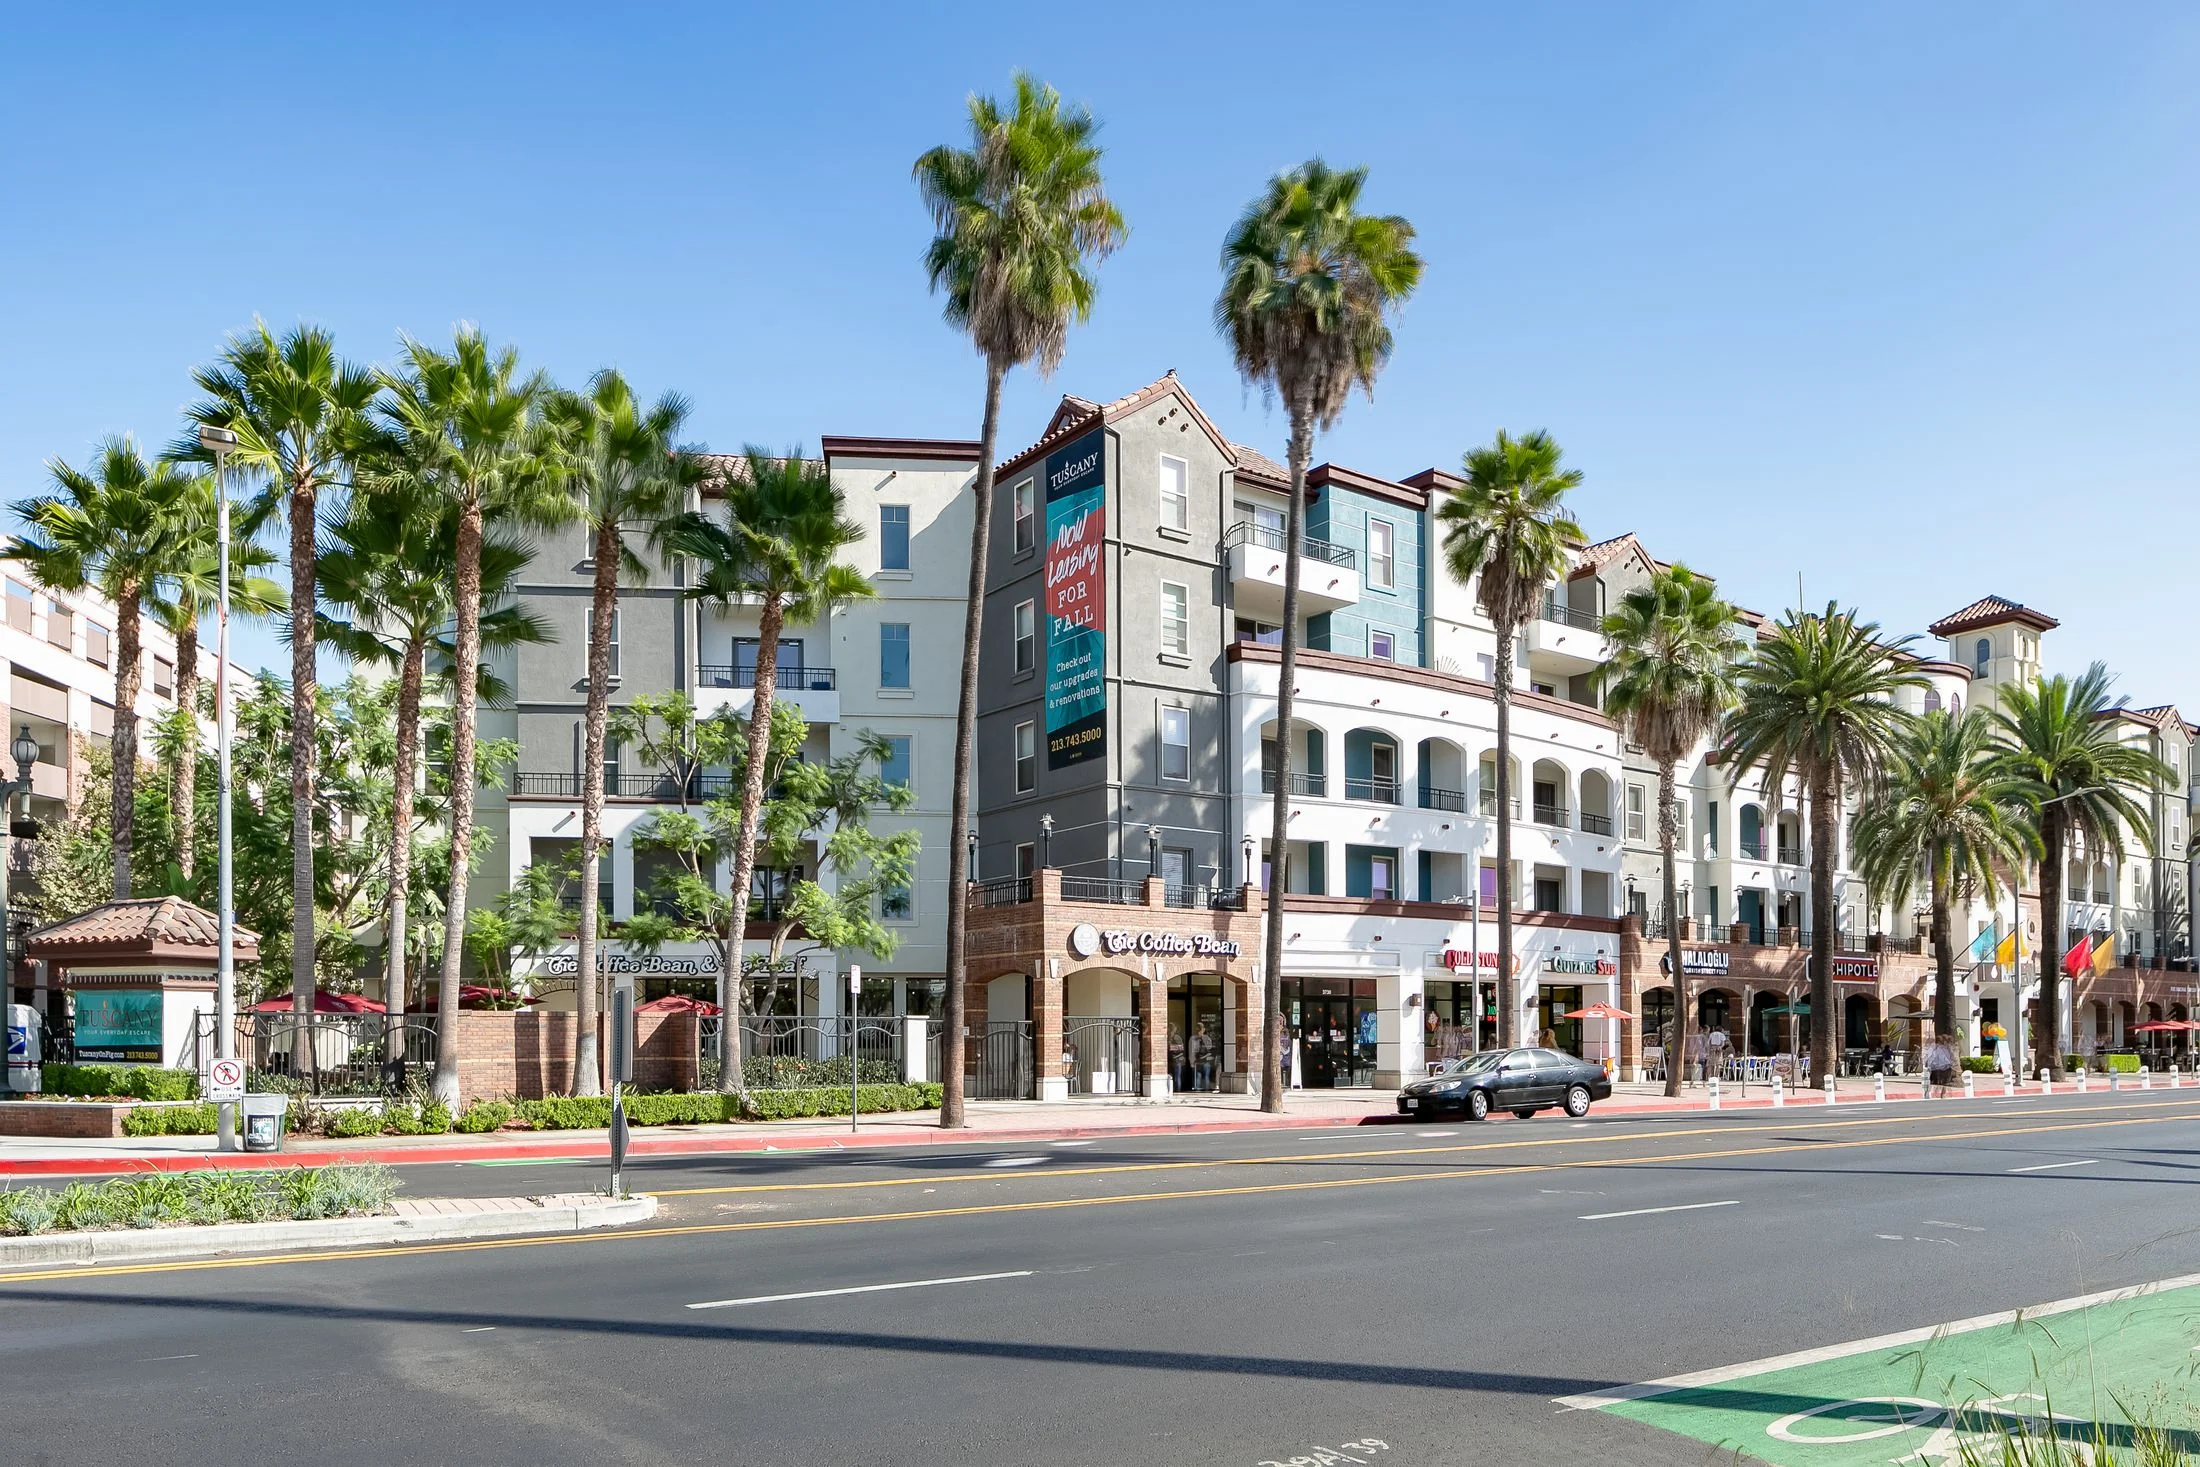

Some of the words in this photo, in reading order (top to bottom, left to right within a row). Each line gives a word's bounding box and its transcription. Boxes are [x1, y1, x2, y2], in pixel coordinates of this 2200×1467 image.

[1050, 451, 1098, 487] TUSCANY
[1047, 543, 1099, 588] Leasing
[1058, 581, 1088, 608] FOR
[1054, 605, 1094, 637] FALL
[1056, 657, 1078, 673] Check
[1078, 652, 1092, 665] out
[1050, 680, 1062, 692] our
[1063, 668, 1098, 688] upgrades
[1049, 699, 1055, 709] &
[1055, 685, 1100, 707] renovations
[1051, 727, 1102, 752] 213.743.5000
[1104, 930, 1137, 953] The
[1140, 931, 1193, 952] Coffee
[1194, 934, 1242, 956] Bean
[544, 955, 578, 975] The
[596, 956, 640, 974] offee
[643, 957, 698, 975] Bean
[699, 957, 718, 972] &
[1445, 950, 1473, 968] COLD
[1478, 951, 1499, 968] STON
[1681, 949, 1729, 967] HALALOĞLU
[78, 1008, 158, 1028] TUSCANY
[126, 1051, 159, 1060] 213.743.5000
